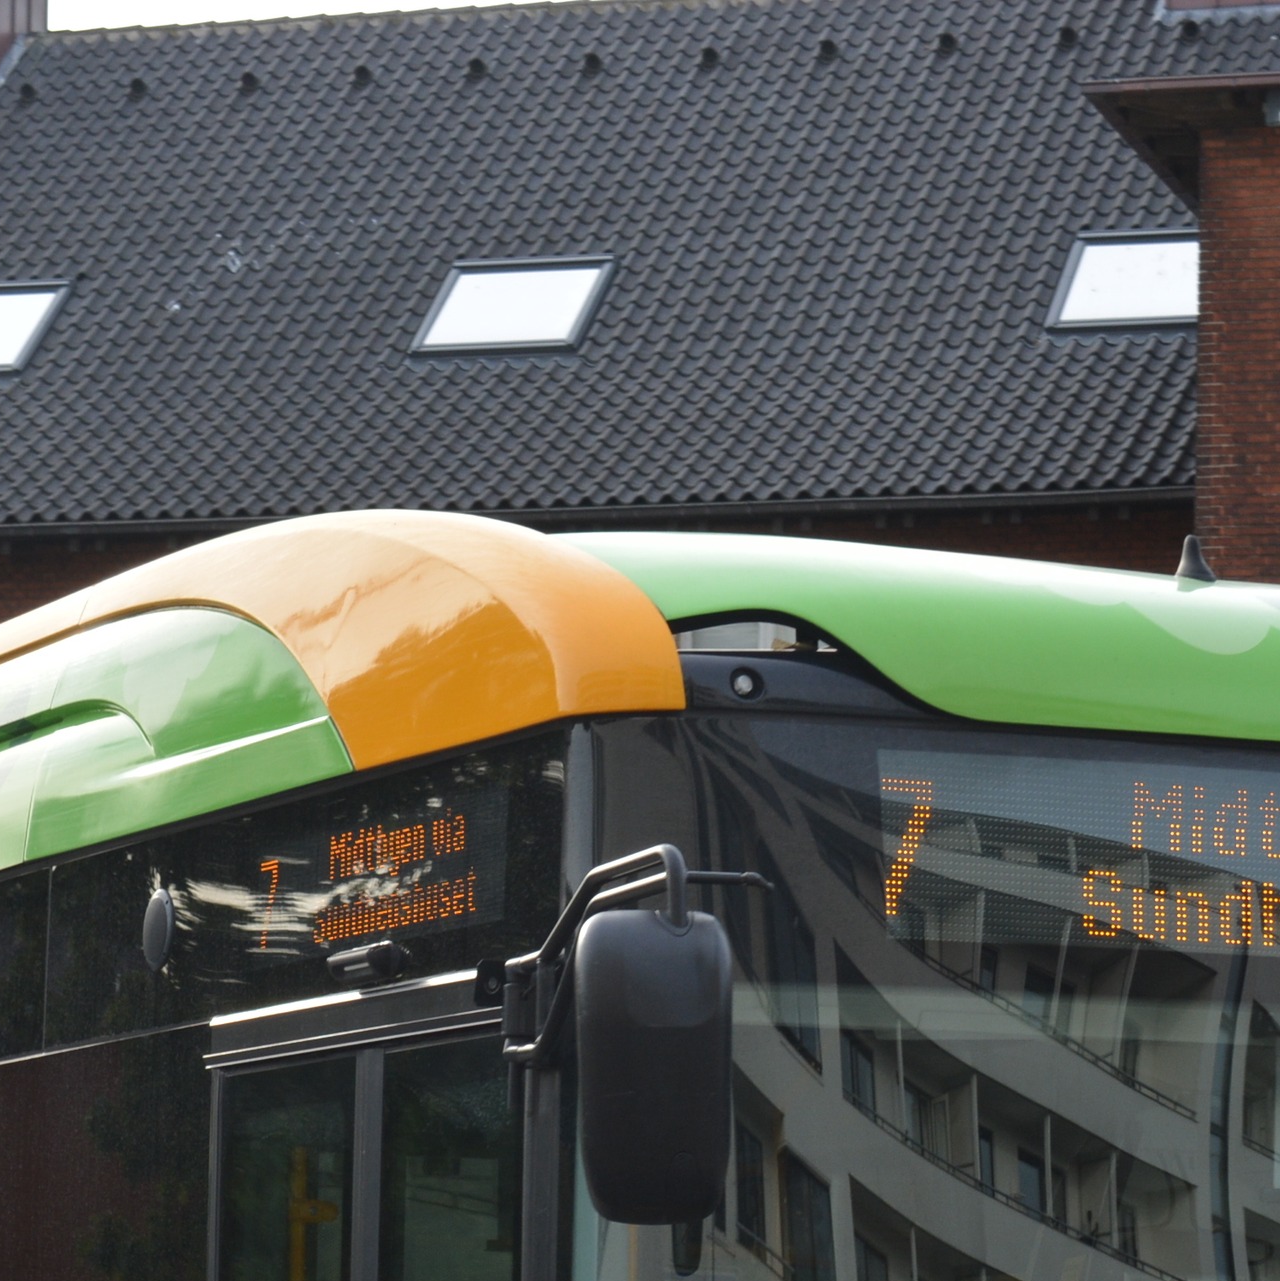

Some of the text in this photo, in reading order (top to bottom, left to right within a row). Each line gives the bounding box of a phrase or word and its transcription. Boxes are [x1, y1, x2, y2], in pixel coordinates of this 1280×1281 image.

[329, 808, 466, 878] Midtbyen via
[881, 778, 932, 916] 7
